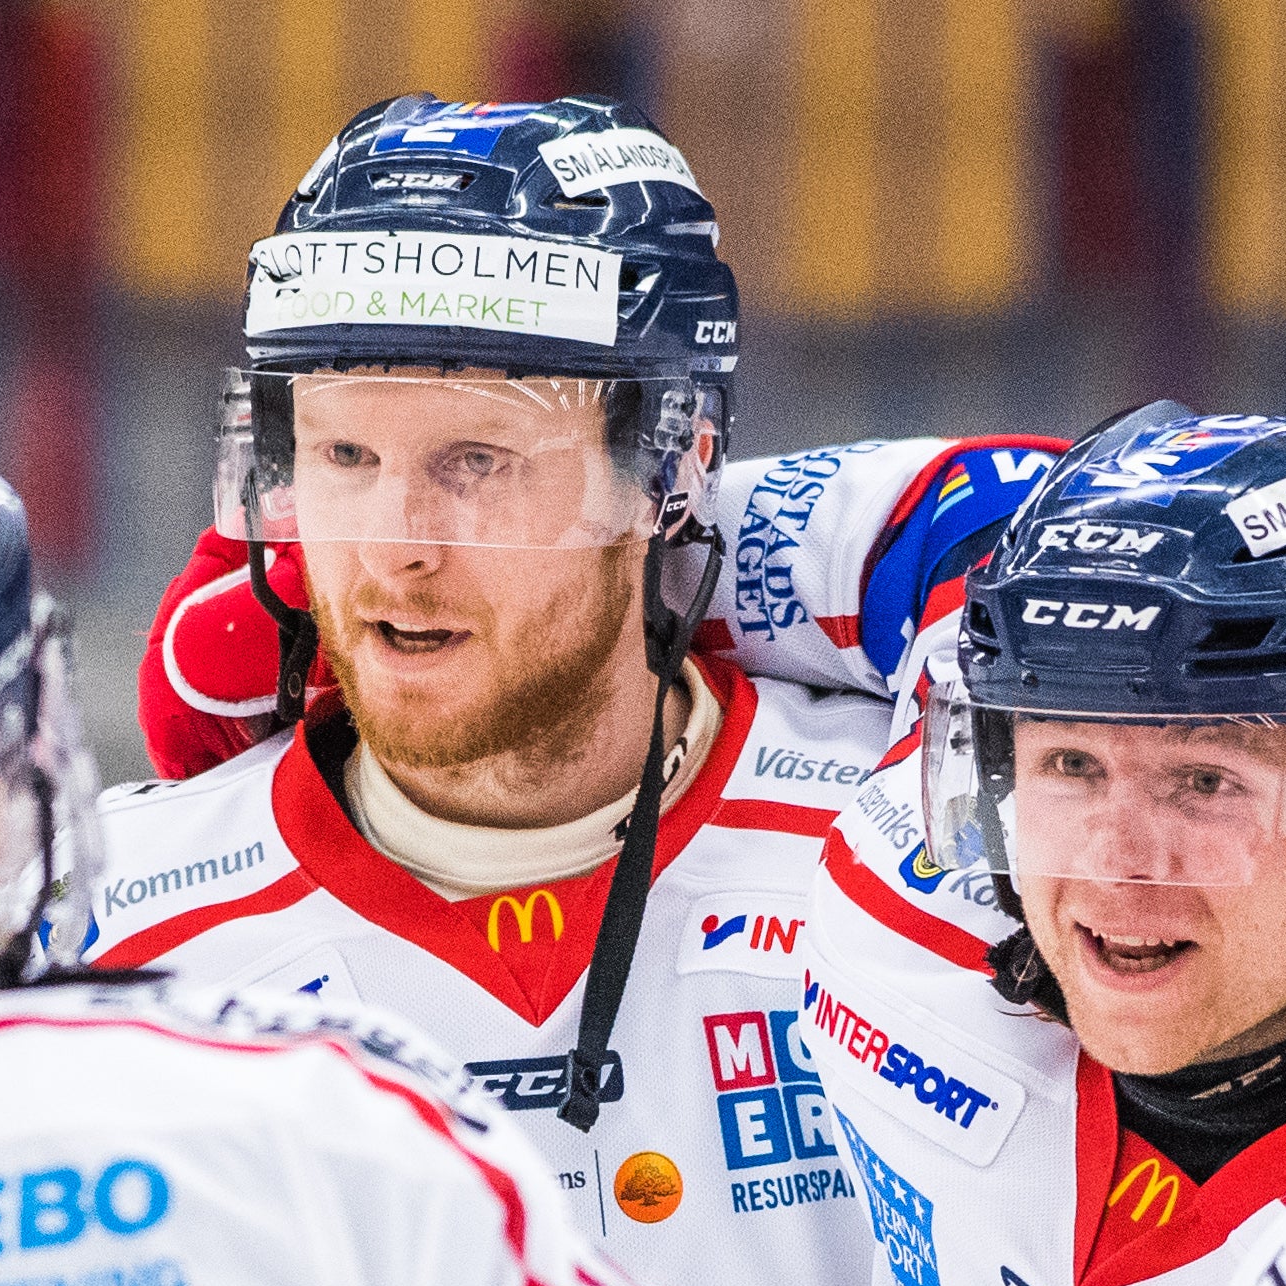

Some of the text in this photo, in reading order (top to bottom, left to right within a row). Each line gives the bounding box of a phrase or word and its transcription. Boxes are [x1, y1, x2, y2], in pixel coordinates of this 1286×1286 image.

[257, 241, 601, 292] SLOTTSHOLMEN
[366, 290, 388, 317] &
[400, 290, 548, 327] MARKET
[695, 320, 737, 344] CCM
[1037, 522, 1165, 555] CCM
[1021, 599, 1162, 631] CCM
[103, 841, 266, 917] Kommun
[815, 988, 991, 1130] INTERSPORT
